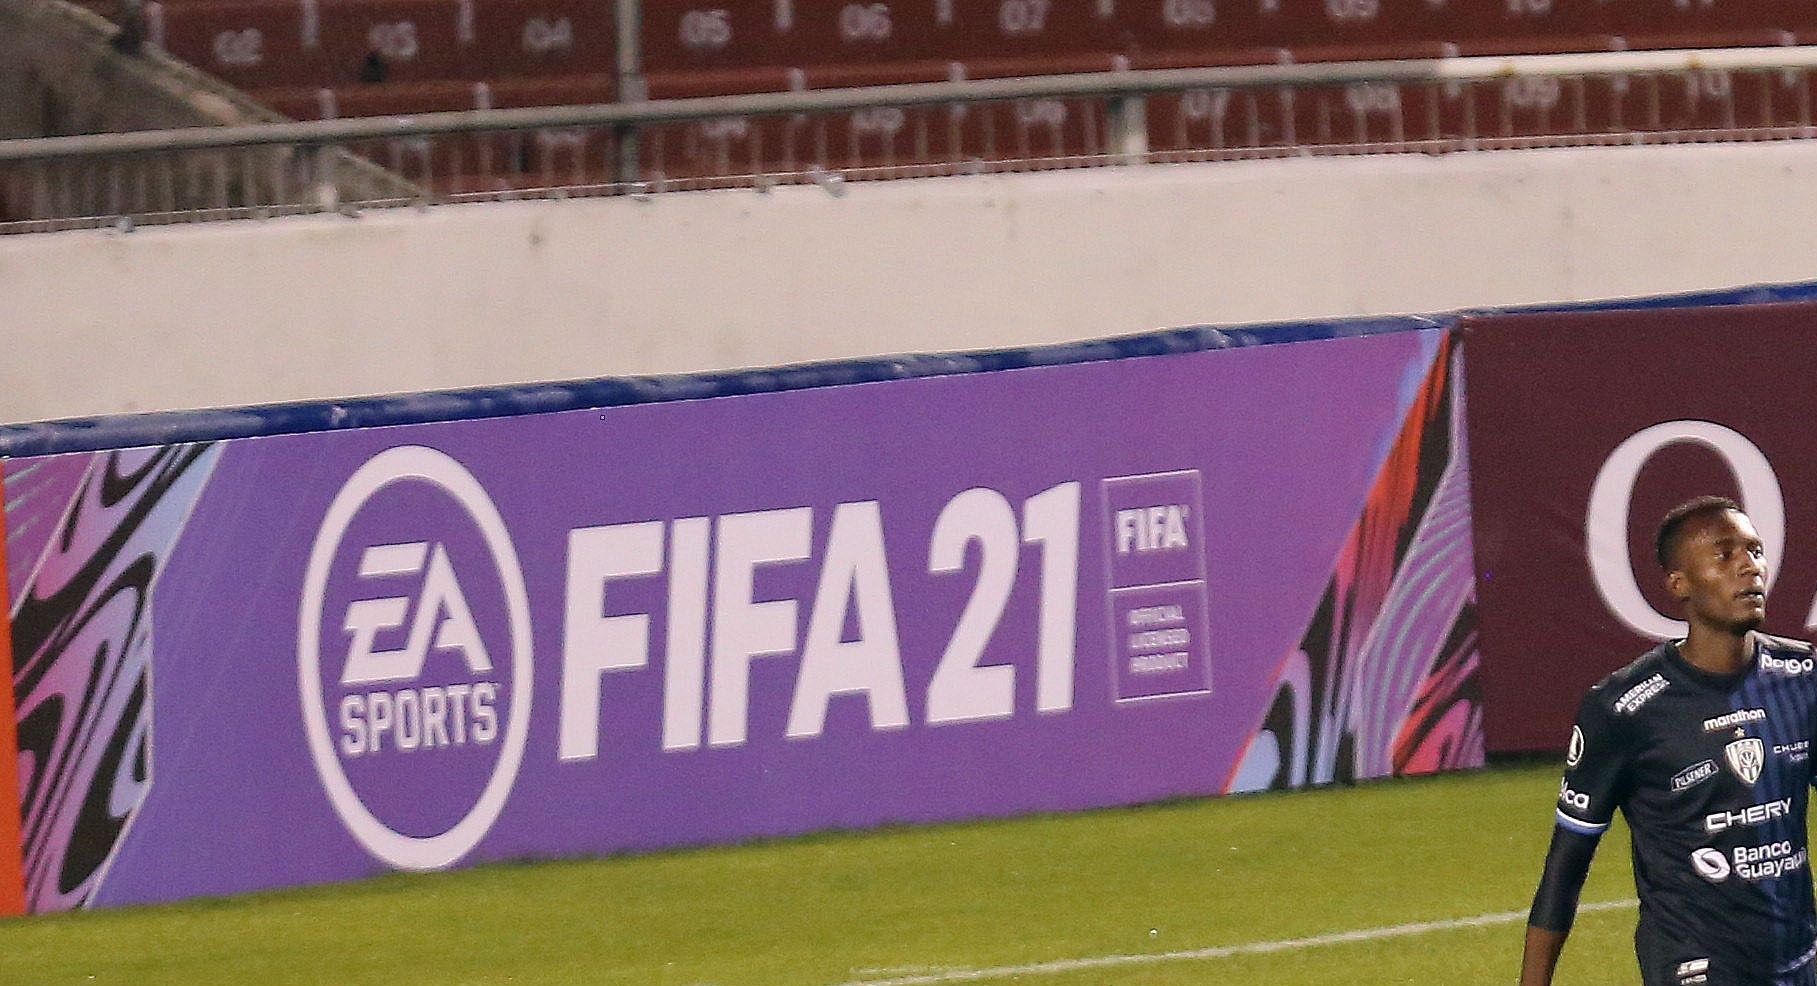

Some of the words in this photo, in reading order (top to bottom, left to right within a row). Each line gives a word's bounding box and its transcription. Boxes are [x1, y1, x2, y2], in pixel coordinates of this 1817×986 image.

[1116, 504, 1190, 553] FIFA
[339, 541, 494, 685] EA
[559, 500, 911, 763] FIFA
[925, 481, 1081, 724] 21
[1614, 673, 1664, 712] AMERICAN
[341, 683, 498, 758] SPORTS
[1703, 708, 1766, 731] marathon
[1674, 763, 1713, 789] PILSENER
[1706, 797, 1792, 831] CHERY
[1733, 840, 1792, 864] Banco
